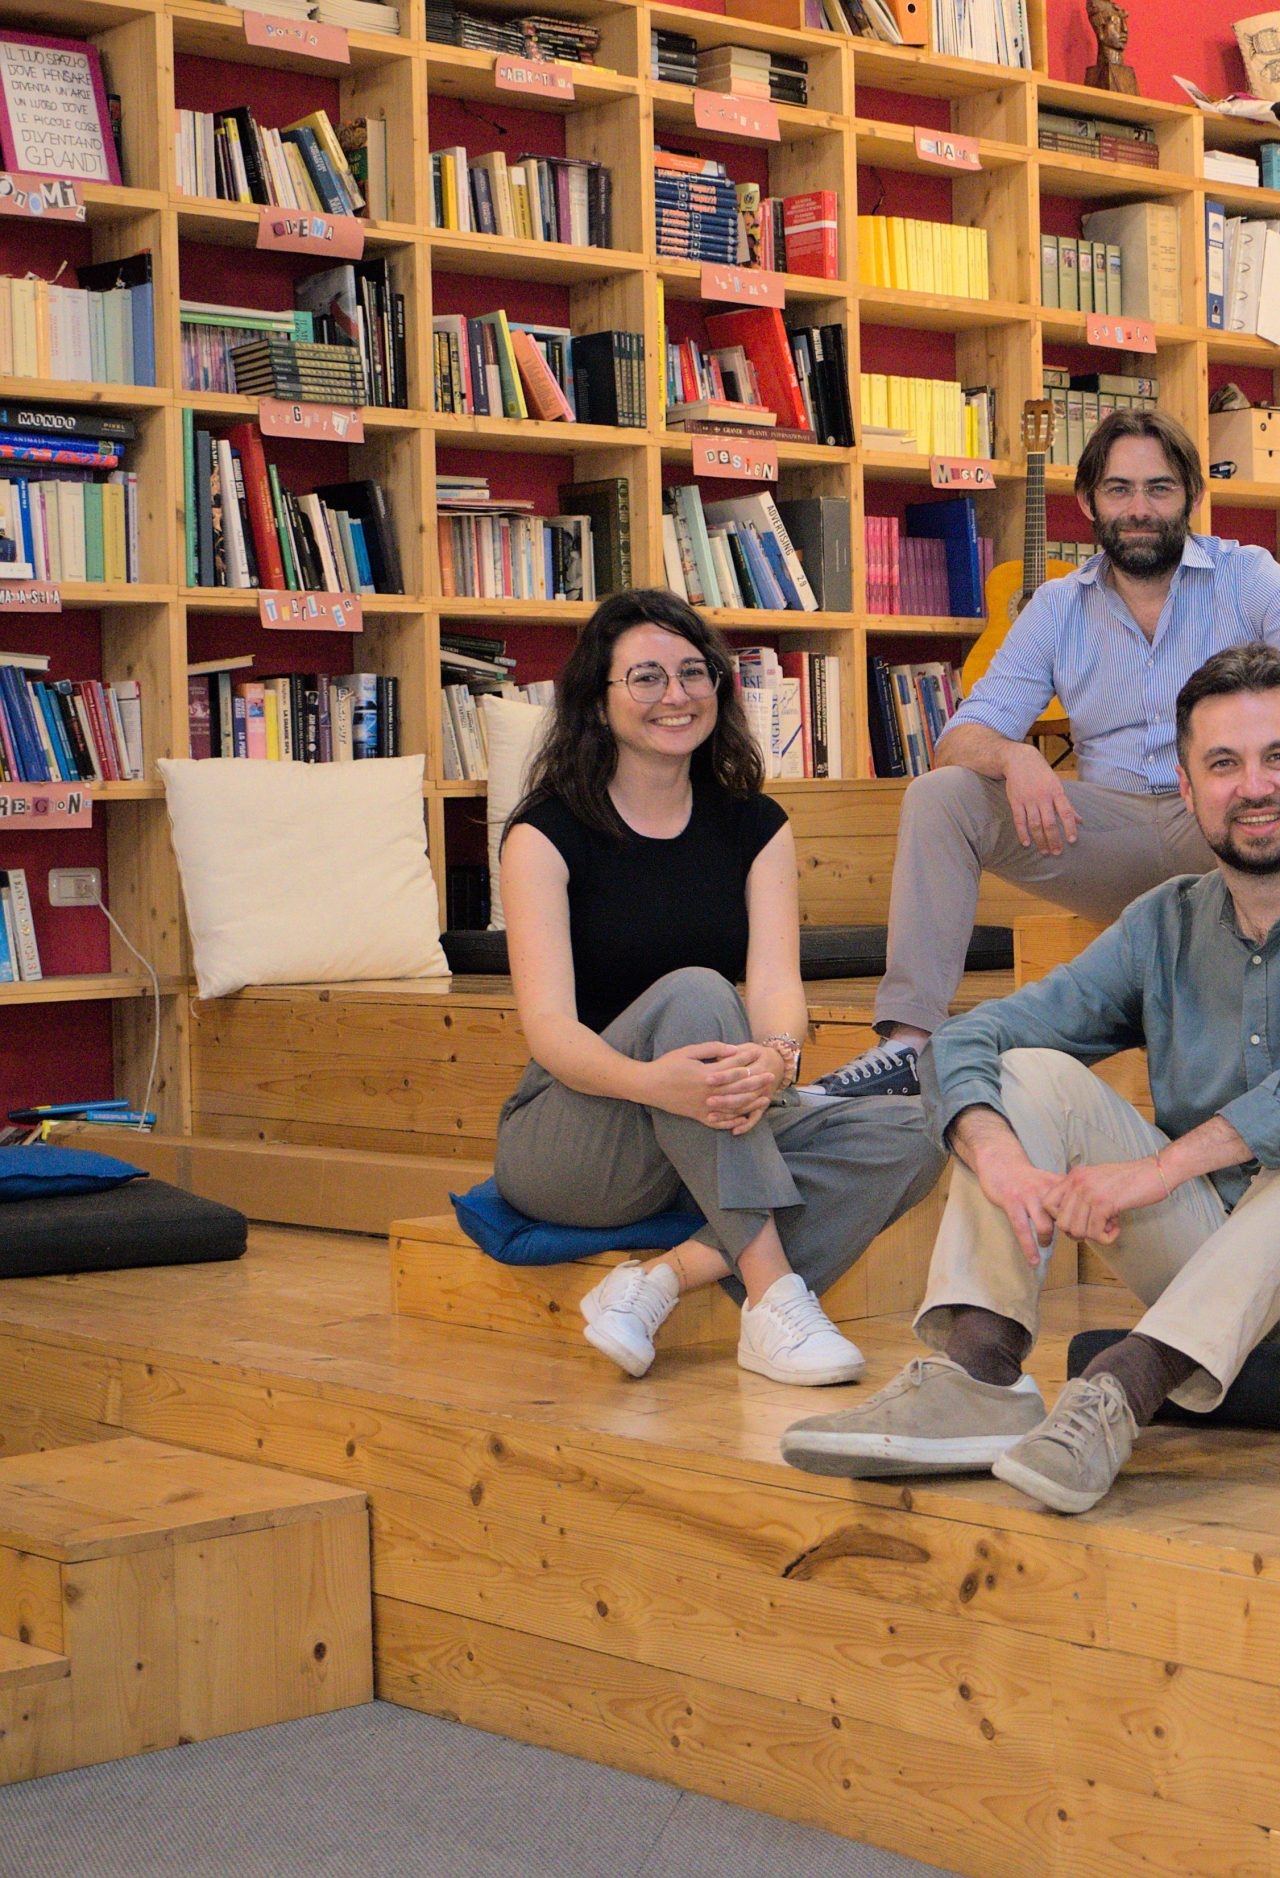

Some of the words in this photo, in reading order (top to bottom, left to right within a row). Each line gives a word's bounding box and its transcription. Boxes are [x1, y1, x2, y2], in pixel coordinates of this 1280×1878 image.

[8, 64, 37, 78] DOVE
[11, 80, 50, 93] DIVENTA
[61, 102, 88, 114] DOVE
[21, 129, 102, 150] DIVENTANO
[25, 145, 103, 173] GRANDI
[18, 411, 76, 430] MONDO
[723, 427, 743, 435] GRANDE
[747, 429, 768, 437] ATLANTE
[767, 504, 794, 557] ADVERTISING
[265, 598, 353, 628] TRILLER
